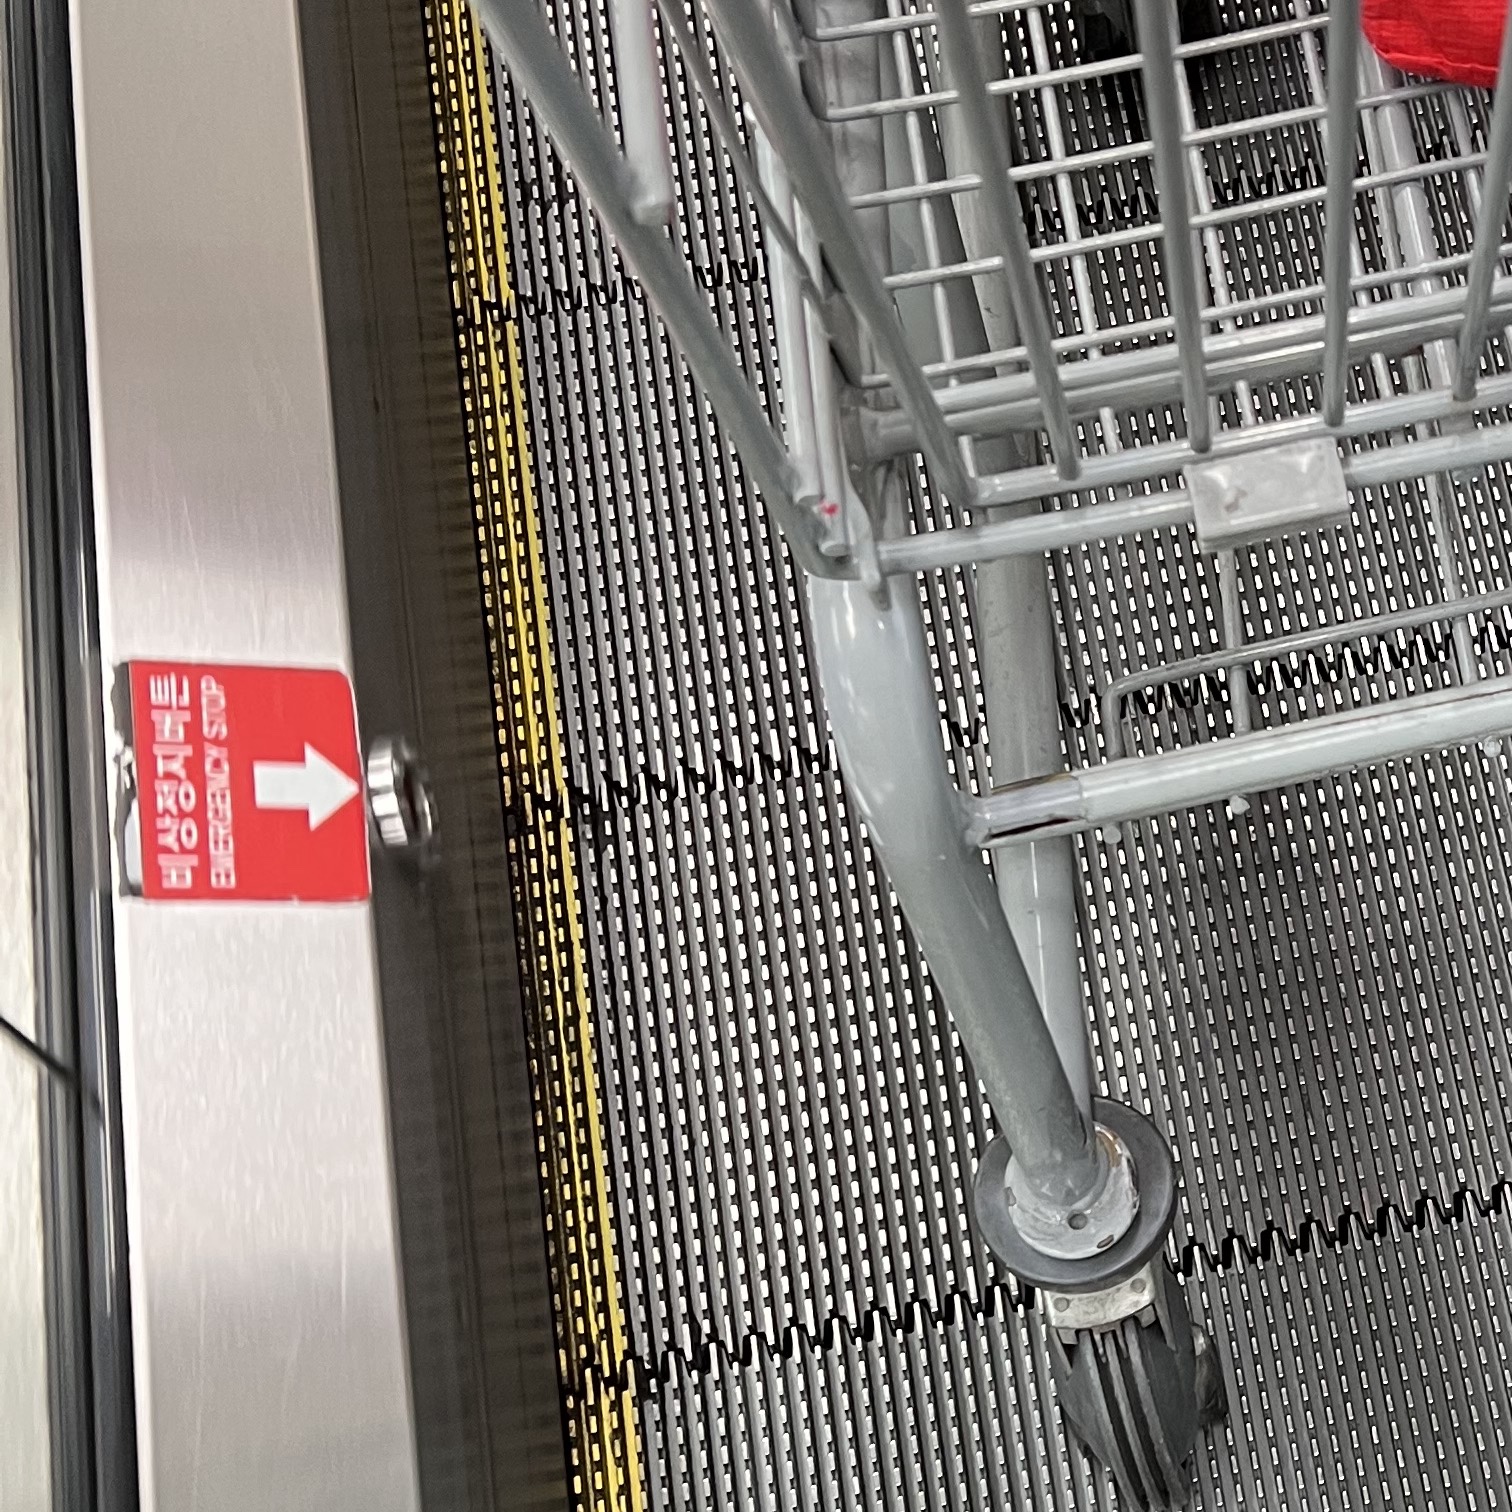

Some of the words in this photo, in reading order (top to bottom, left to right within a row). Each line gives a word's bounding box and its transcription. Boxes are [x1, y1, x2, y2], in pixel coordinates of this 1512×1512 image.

[150, 672, 198, 889] 비상정지버튼
[200, 674, 228, 740] STOP
[204, 741, 236, 889] EMERGENCY
